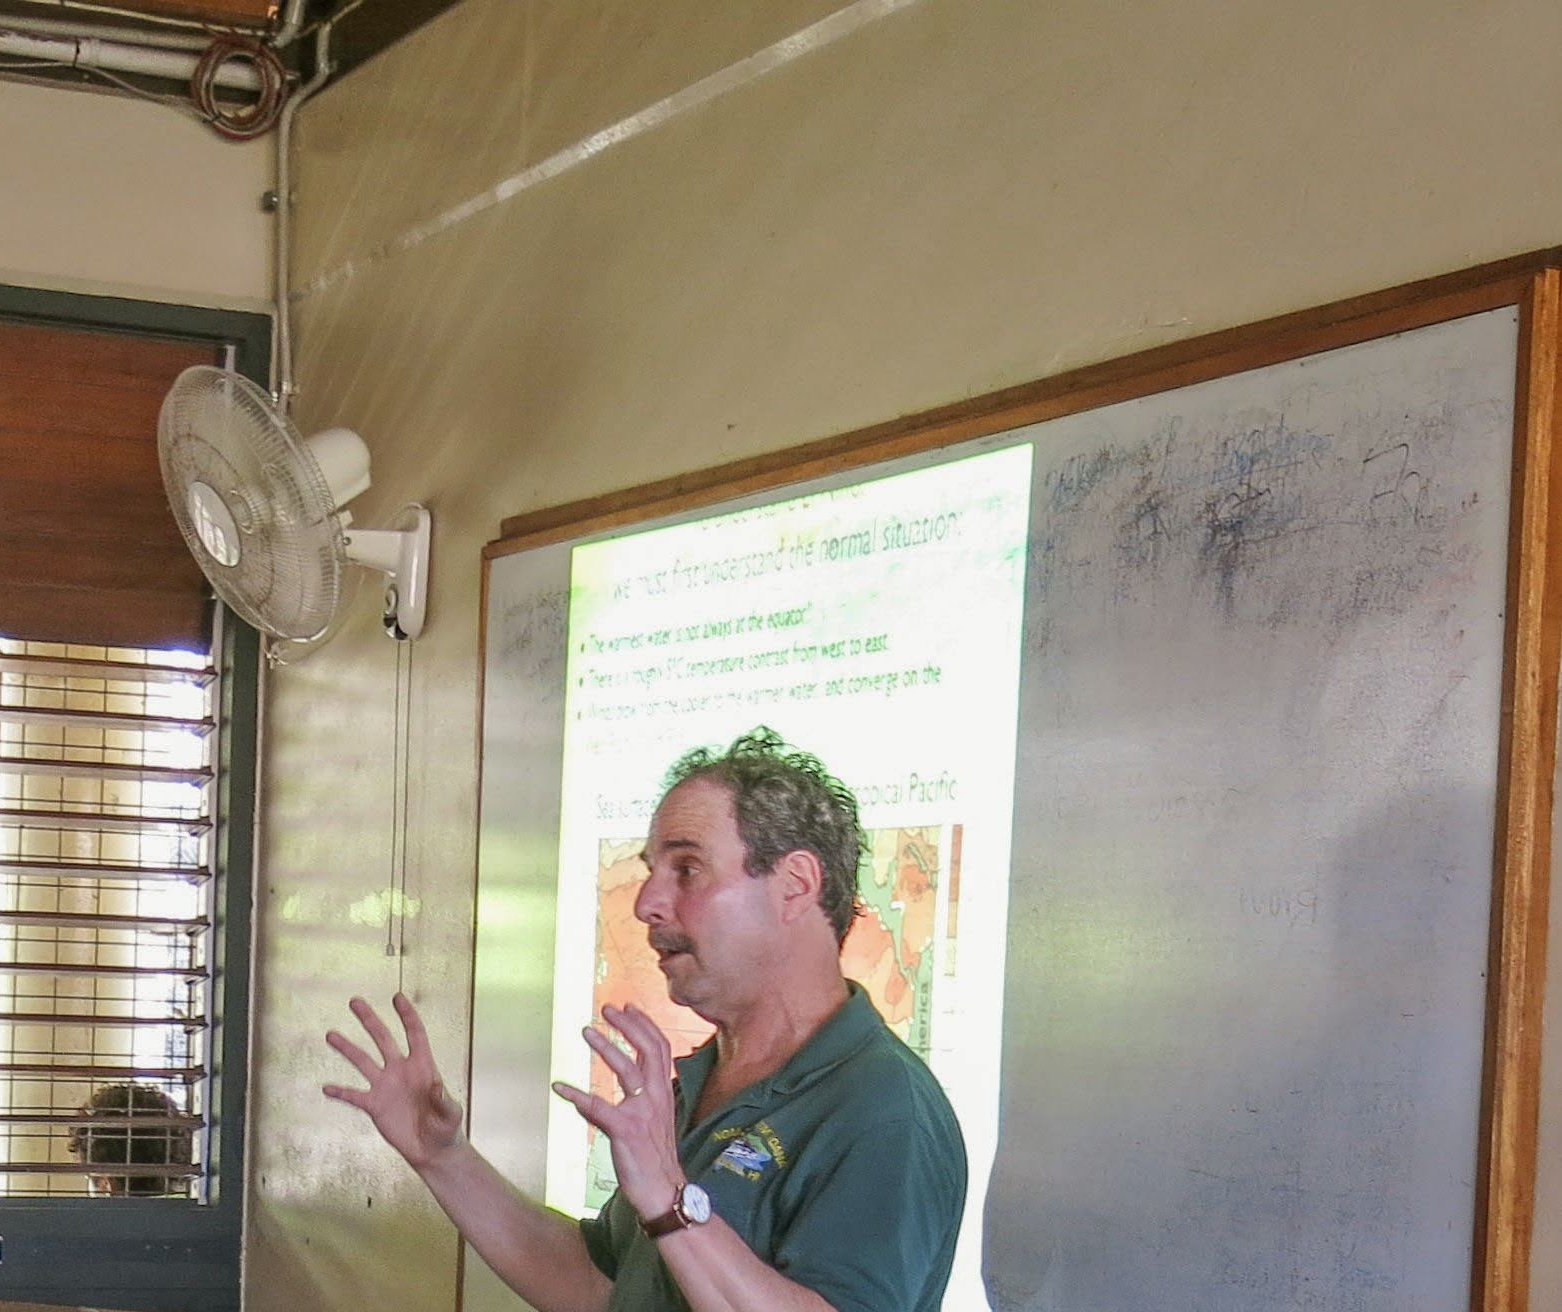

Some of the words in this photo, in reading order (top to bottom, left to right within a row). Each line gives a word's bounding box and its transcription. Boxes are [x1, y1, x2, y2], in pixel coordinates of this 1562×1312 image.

[819, 517, 877, 563] normal
[702, 618, 733, 641] always
[820, 638, 846, 659] west
[848, 637, 862, 656] to
[847, 672, 899, 699] converge
[901, 669, 918, 687] on
[921, 662, 942, 685] the
[908, 769, 959, 804] Pacific
